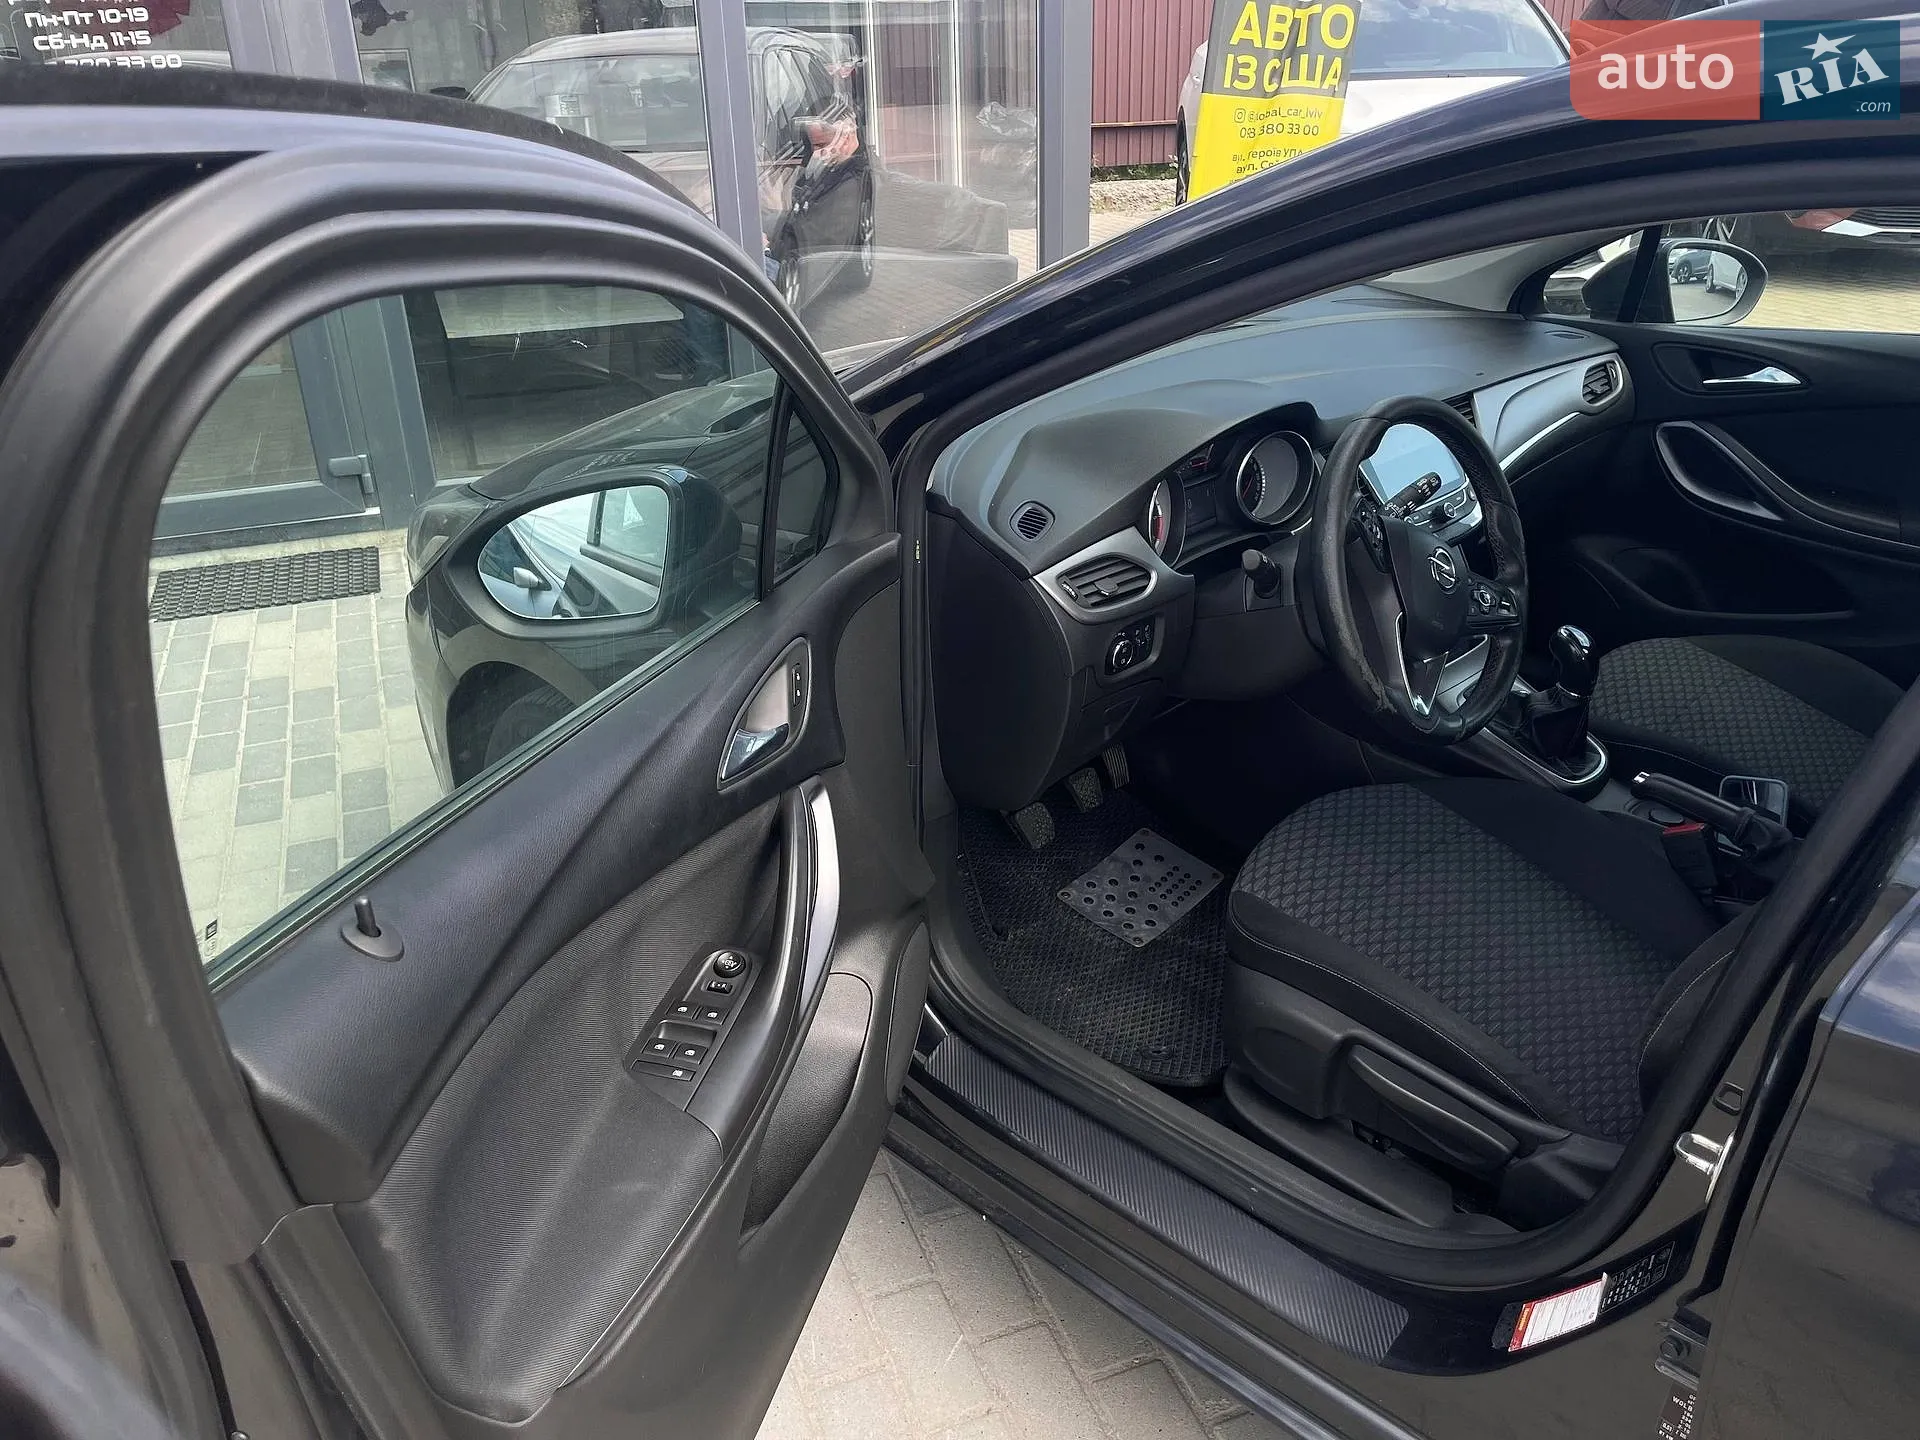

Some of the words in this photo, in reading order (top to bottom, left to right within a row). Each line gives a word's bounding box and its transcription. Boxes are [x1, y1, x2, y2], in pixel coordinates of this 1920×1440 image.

[24, 11, 94, 28] Пн-Пт
[97, 7, 149, 24] 10-19
[1229, 0, 1355, 50] АВТО
[33, 32, 108, 51] Сб-Нд
[110, 30, 152, 46] 11-15
[1263, 54, 1343, 93] США
[1302, 124, 1320, 137] 00
